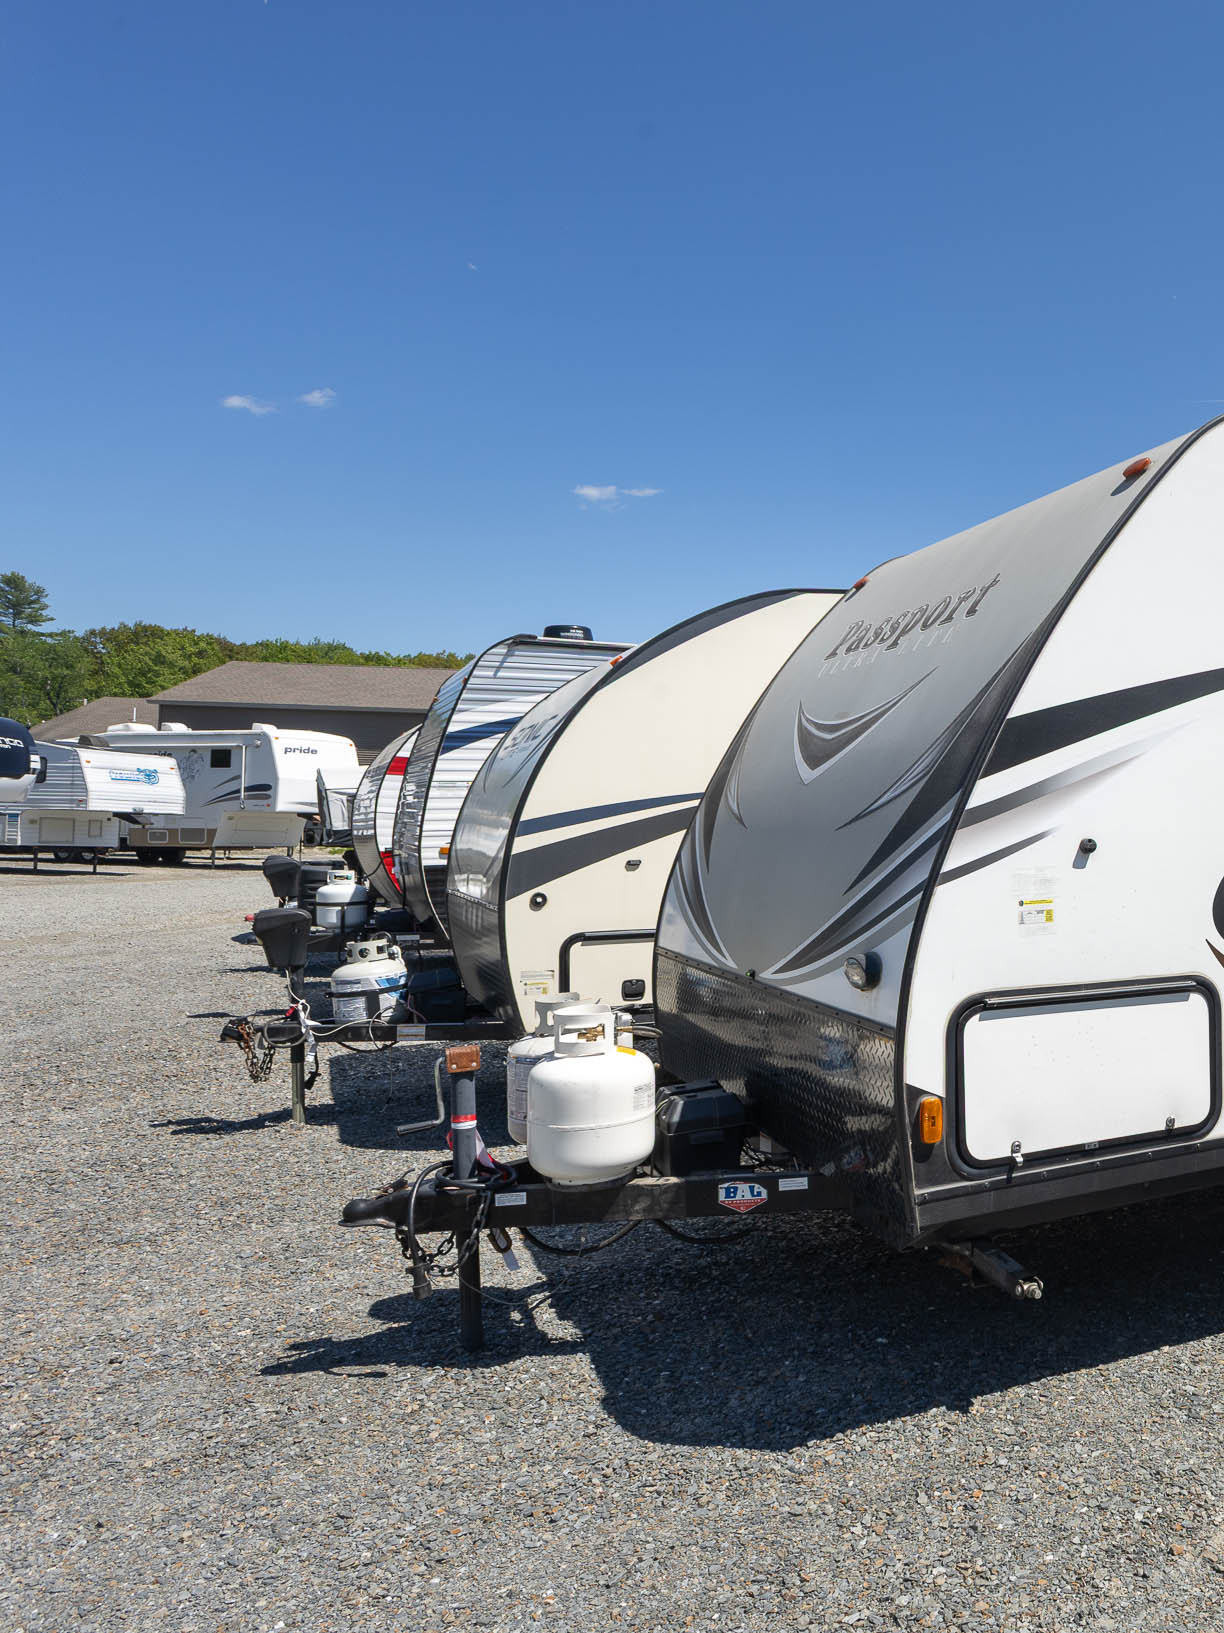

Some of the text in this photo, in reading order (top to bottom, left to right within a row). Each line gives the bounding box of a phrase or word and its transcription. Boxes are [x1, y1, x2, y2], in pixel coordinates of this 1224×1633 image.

[824, 573, 1001, 661] Passport
[284, 746, 318, 755] pride
[724, 1185, 762, 1199] BAL
